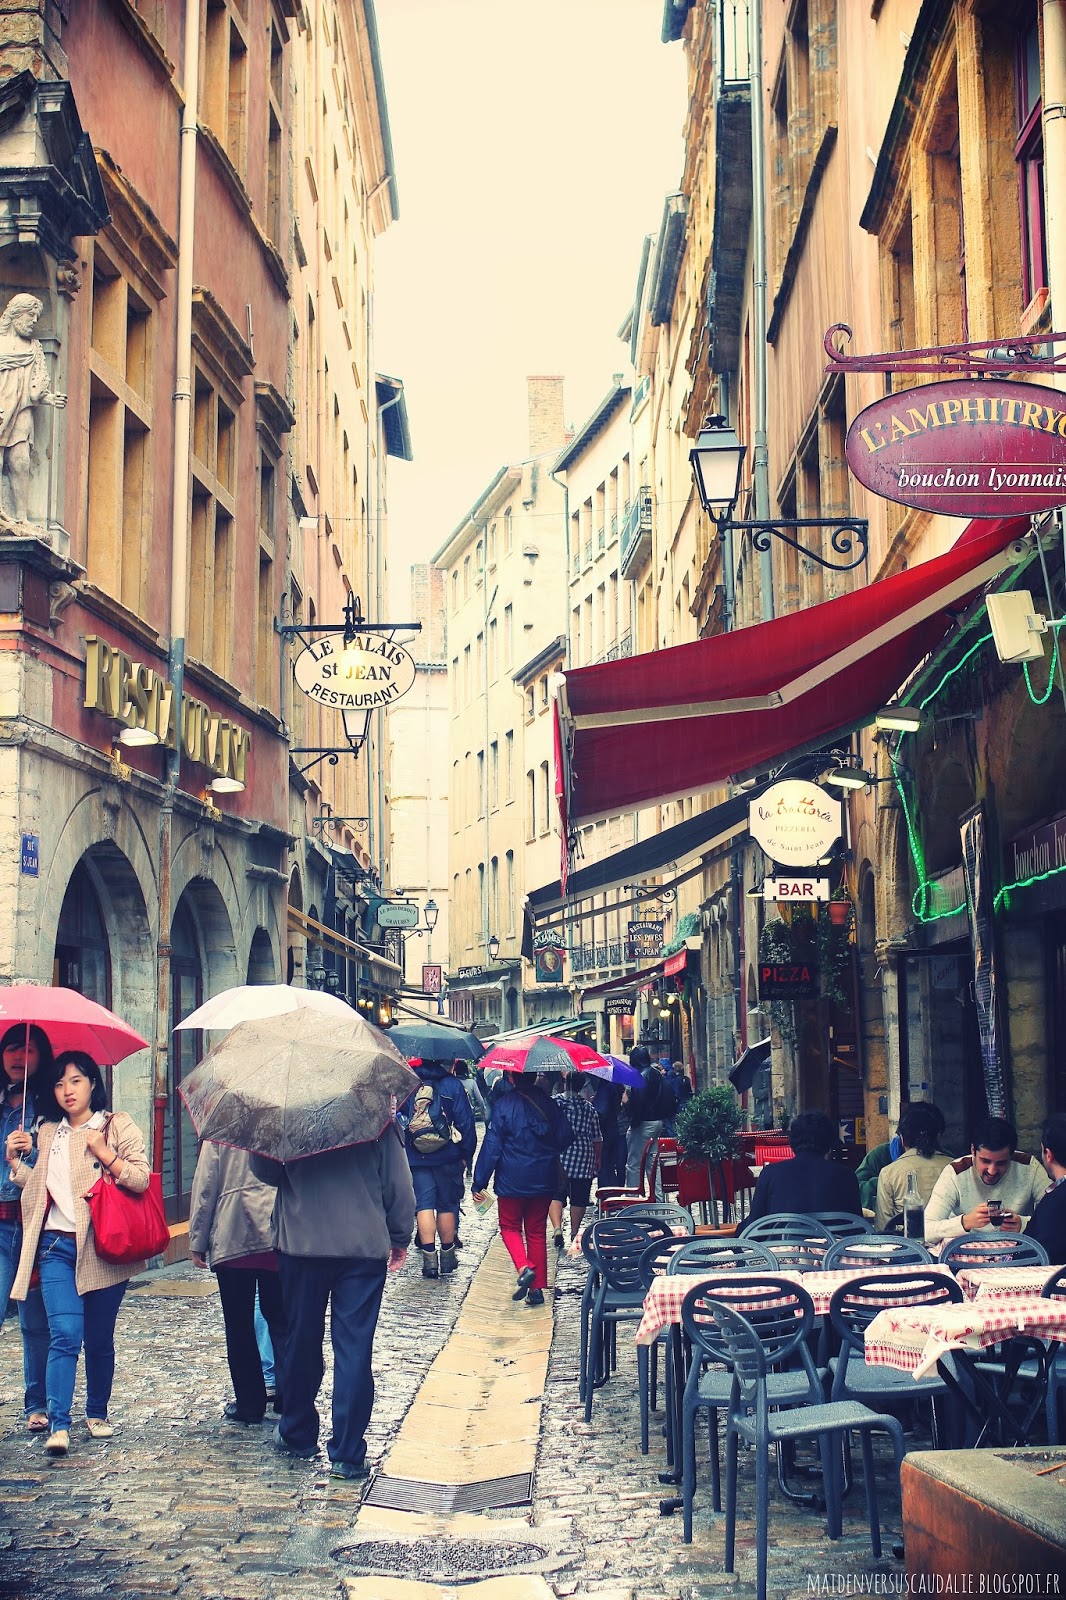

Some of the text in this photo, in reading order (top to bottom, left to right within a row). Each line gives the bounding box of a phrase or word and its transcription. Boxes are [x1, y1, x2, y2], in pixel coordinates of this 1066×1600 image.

[898, 468, 980, 488] bouchon
[308, 636, 405, 665] LE PALAIS
[322, 662, 392, 681] St JEAN
[310, 682, 399, 706] RESTAURANT
[84, 635, 251, 784] RESTAURANT
[758, 797, 832, 823] la trattoria
[27, 840, 35, 851] RUE
[805, 840, 824, 851] Jean
[27, 856, 38, 868] JEAN
[1013, 835, 1051, 880] bouchon
[779, 883, 813, 896] BAR
[629, 922, 662, 934] RESTAURANT
[762, 966, 810, 982] PIZZA
